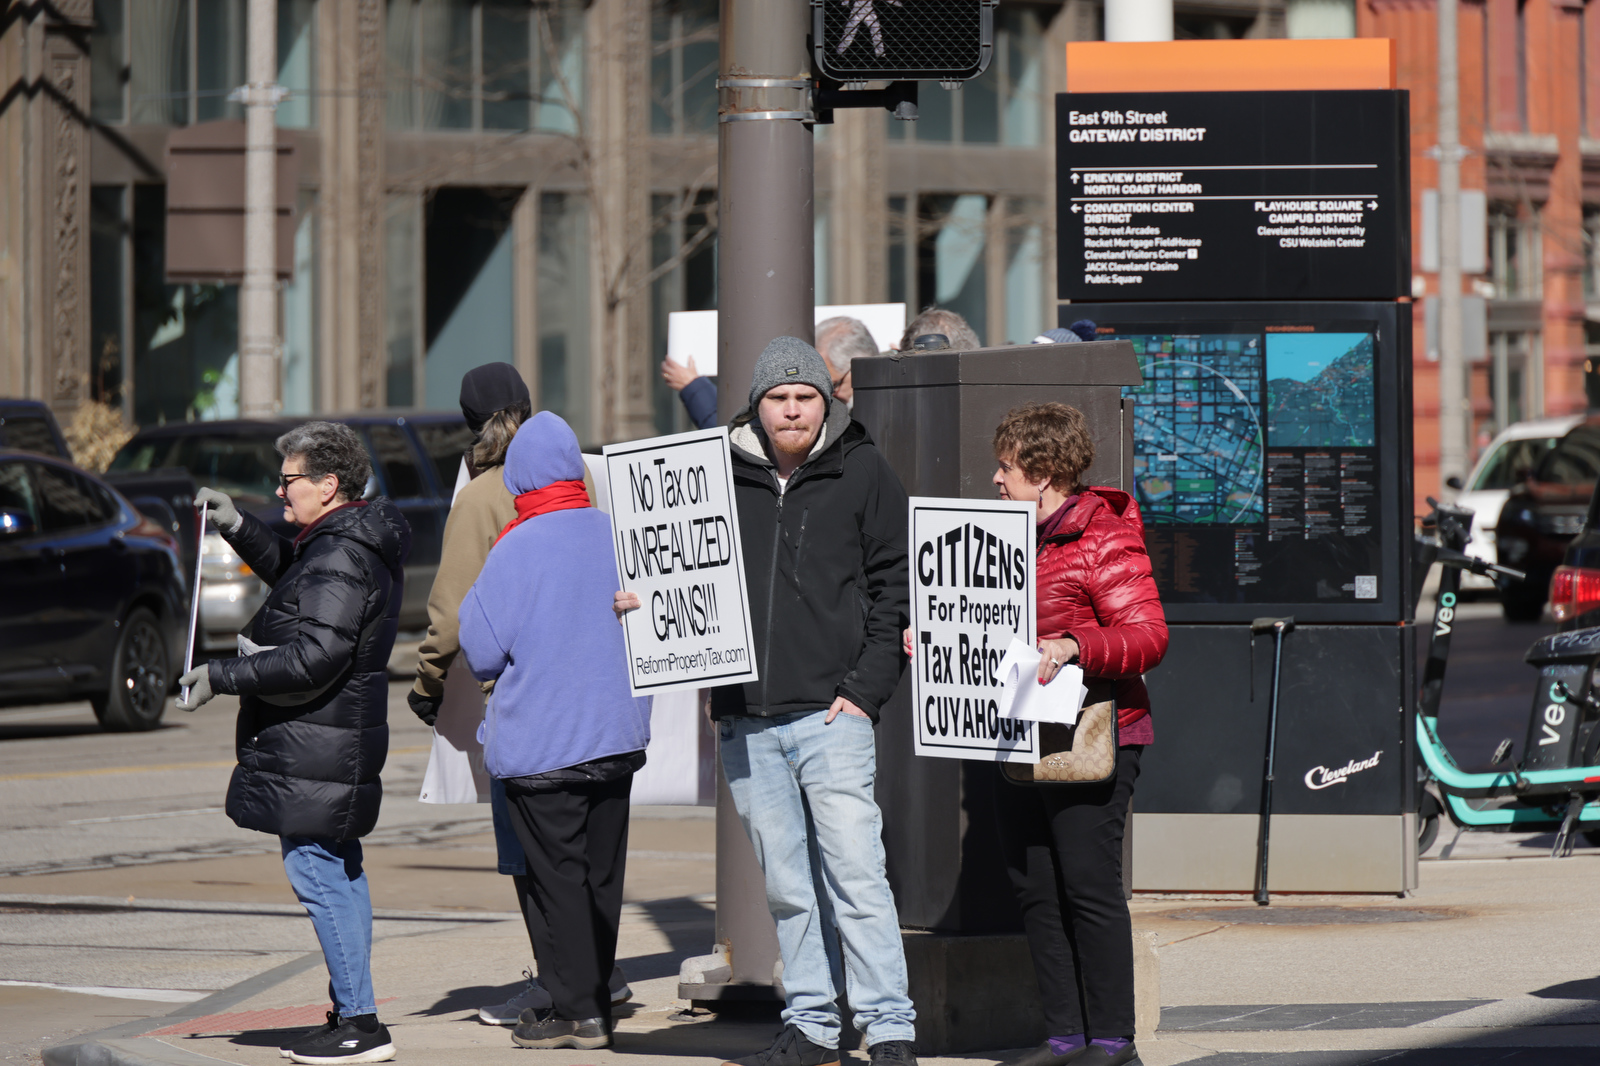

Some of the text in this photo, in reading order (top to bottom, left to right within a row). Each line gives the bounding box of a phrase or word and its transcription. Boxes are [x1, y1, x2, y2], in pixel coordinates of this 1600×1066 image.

[1069, 110, 1168, 125] East 9th Street
[1069, 128, 1207, 143] GATEWAY DISTRICT
[1083, 172, 1183, 184] ERIEVIEW DISTRICT
[1083, 183, 1202, 195] NORTH COAST HARBOR
[1084, 202, 1194, 213] CONVENTION CENTER
[1254, 200, 1364, 212] PLAYHOUSE SQUARE
[1084, 213, 1132, 224] DISTRICT
[1268, 212, 1364, 224] CAMPUS DISTRICT
[1084, 225, 1160, 236] 5th Street Arcades
[1257, 225, 1366, 237] Cleveland State University
[1084, 237, 1202, 250] Rocket Mortgage FieldHouse
[1279, 237, 1366, 247] CSU Wolstein Center
[1084, 249, 1187, 260] Cleveland Visitors Center
[1084, 261, 1179, 272] JACK Cleveland Casino
[1084, 274, 1143, 285] Public Square
[628, 458, 709, 514] No Tax on
[620, 515, 732, 580] UNREALIZED
[918, 522, 1025, 590] CITIZENS
[651, 582, 721, 642] GAINS!!!
[928, 594, 1021, 634] For Property
[1435, 591, 1457, 637] veo
[635, 646, 747, 676] ReformPropertyTax.com
[920, 631, 1006, 688] Tax Refo
[1304, 750, 1380, 790] Cleveland
